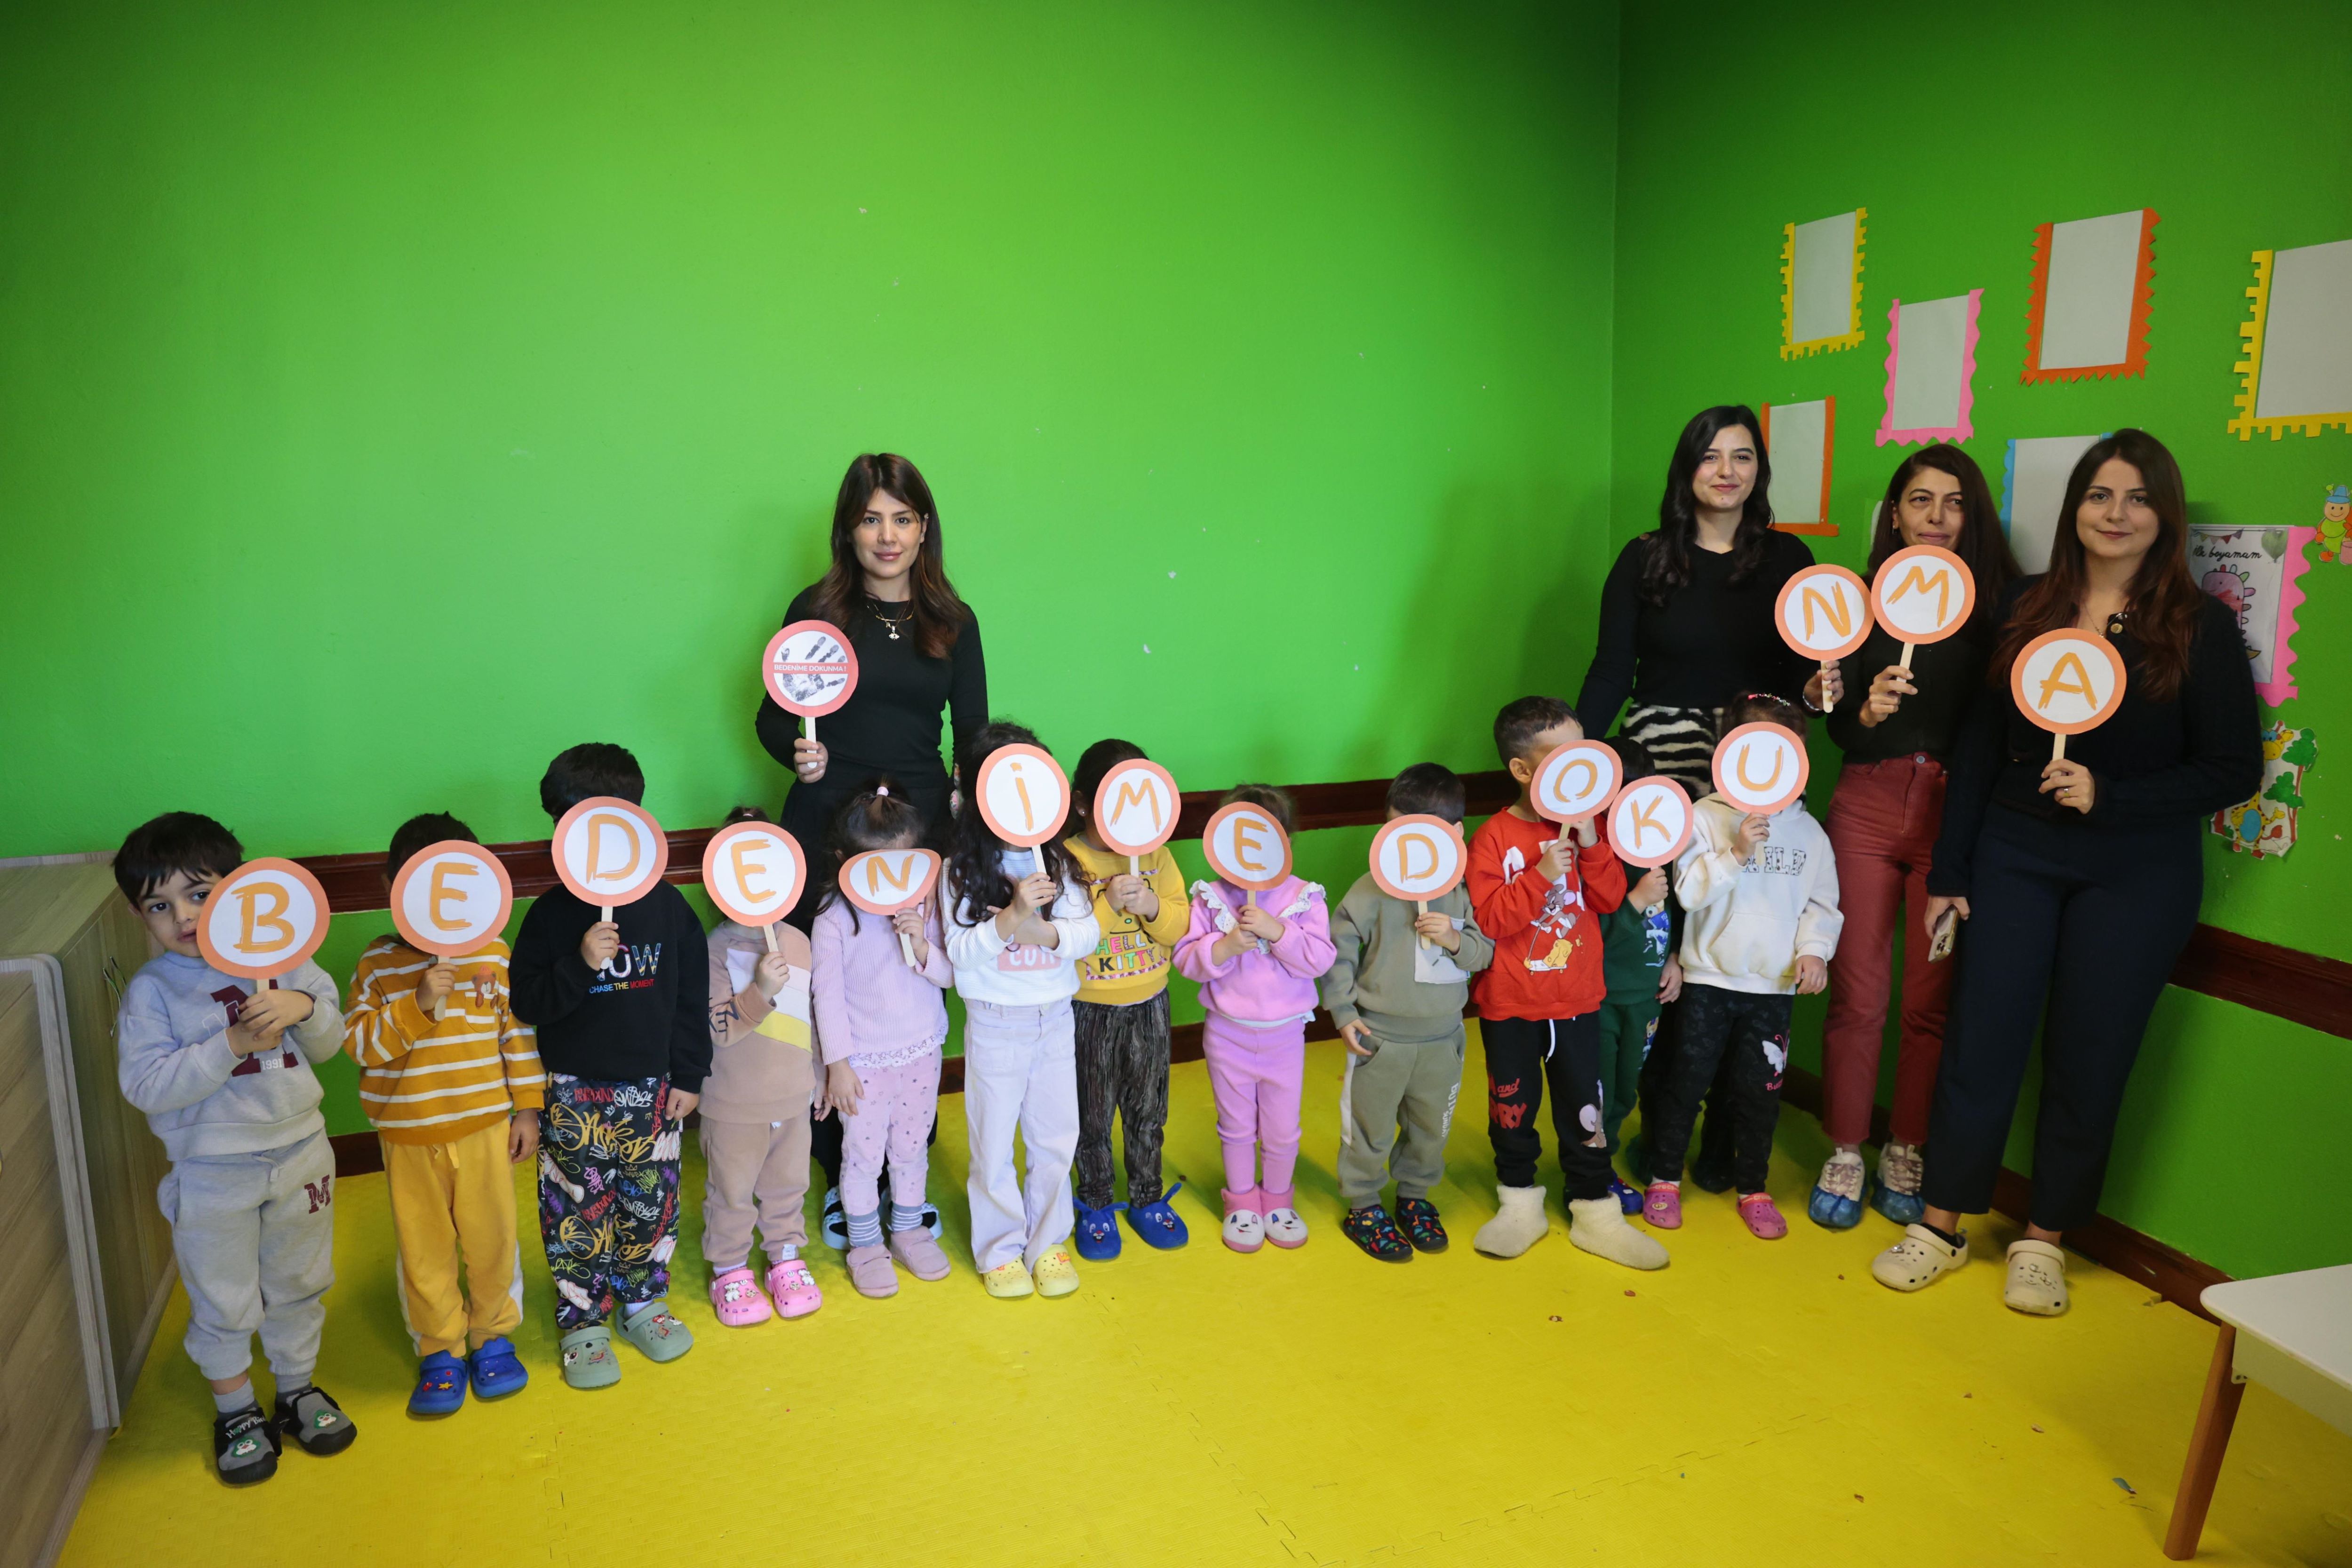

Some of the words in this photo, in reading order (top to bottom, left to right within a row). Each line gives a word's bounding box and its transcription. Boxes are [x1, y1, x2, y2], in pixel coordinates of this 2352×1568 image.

[2208, 546, 2262, 562] boyamam
[1802, 581, 1850, 641] N
[1886, 566, 1949, 627] M
[2038, 652, 2097, 710] A
[1554, 759, 1597, 802] O
[1737, 743, 1783, 791] U
[1110, 778, 1161, 833] M
[1631, 796, 1671, 849] K
[586, 813, 640, 883] D
[731, 839, 776, 903] E
[1233, 818, 1268, 871] E
[1397, 833, 1438, 883] D
[429, 862, 479, 931] E
[866, 854, 915, 896] N
[231, 882, 295, 953] B
[589, 983, 614, 994] CHASE
[614, 981, 629, 990] THE
[630, 979, 655, 989] MOMENT
[597, 943, 662, 981] OW
[1100, 949, 1155, 972] KITTY
[262, 1059, 282, 1070] 1991
